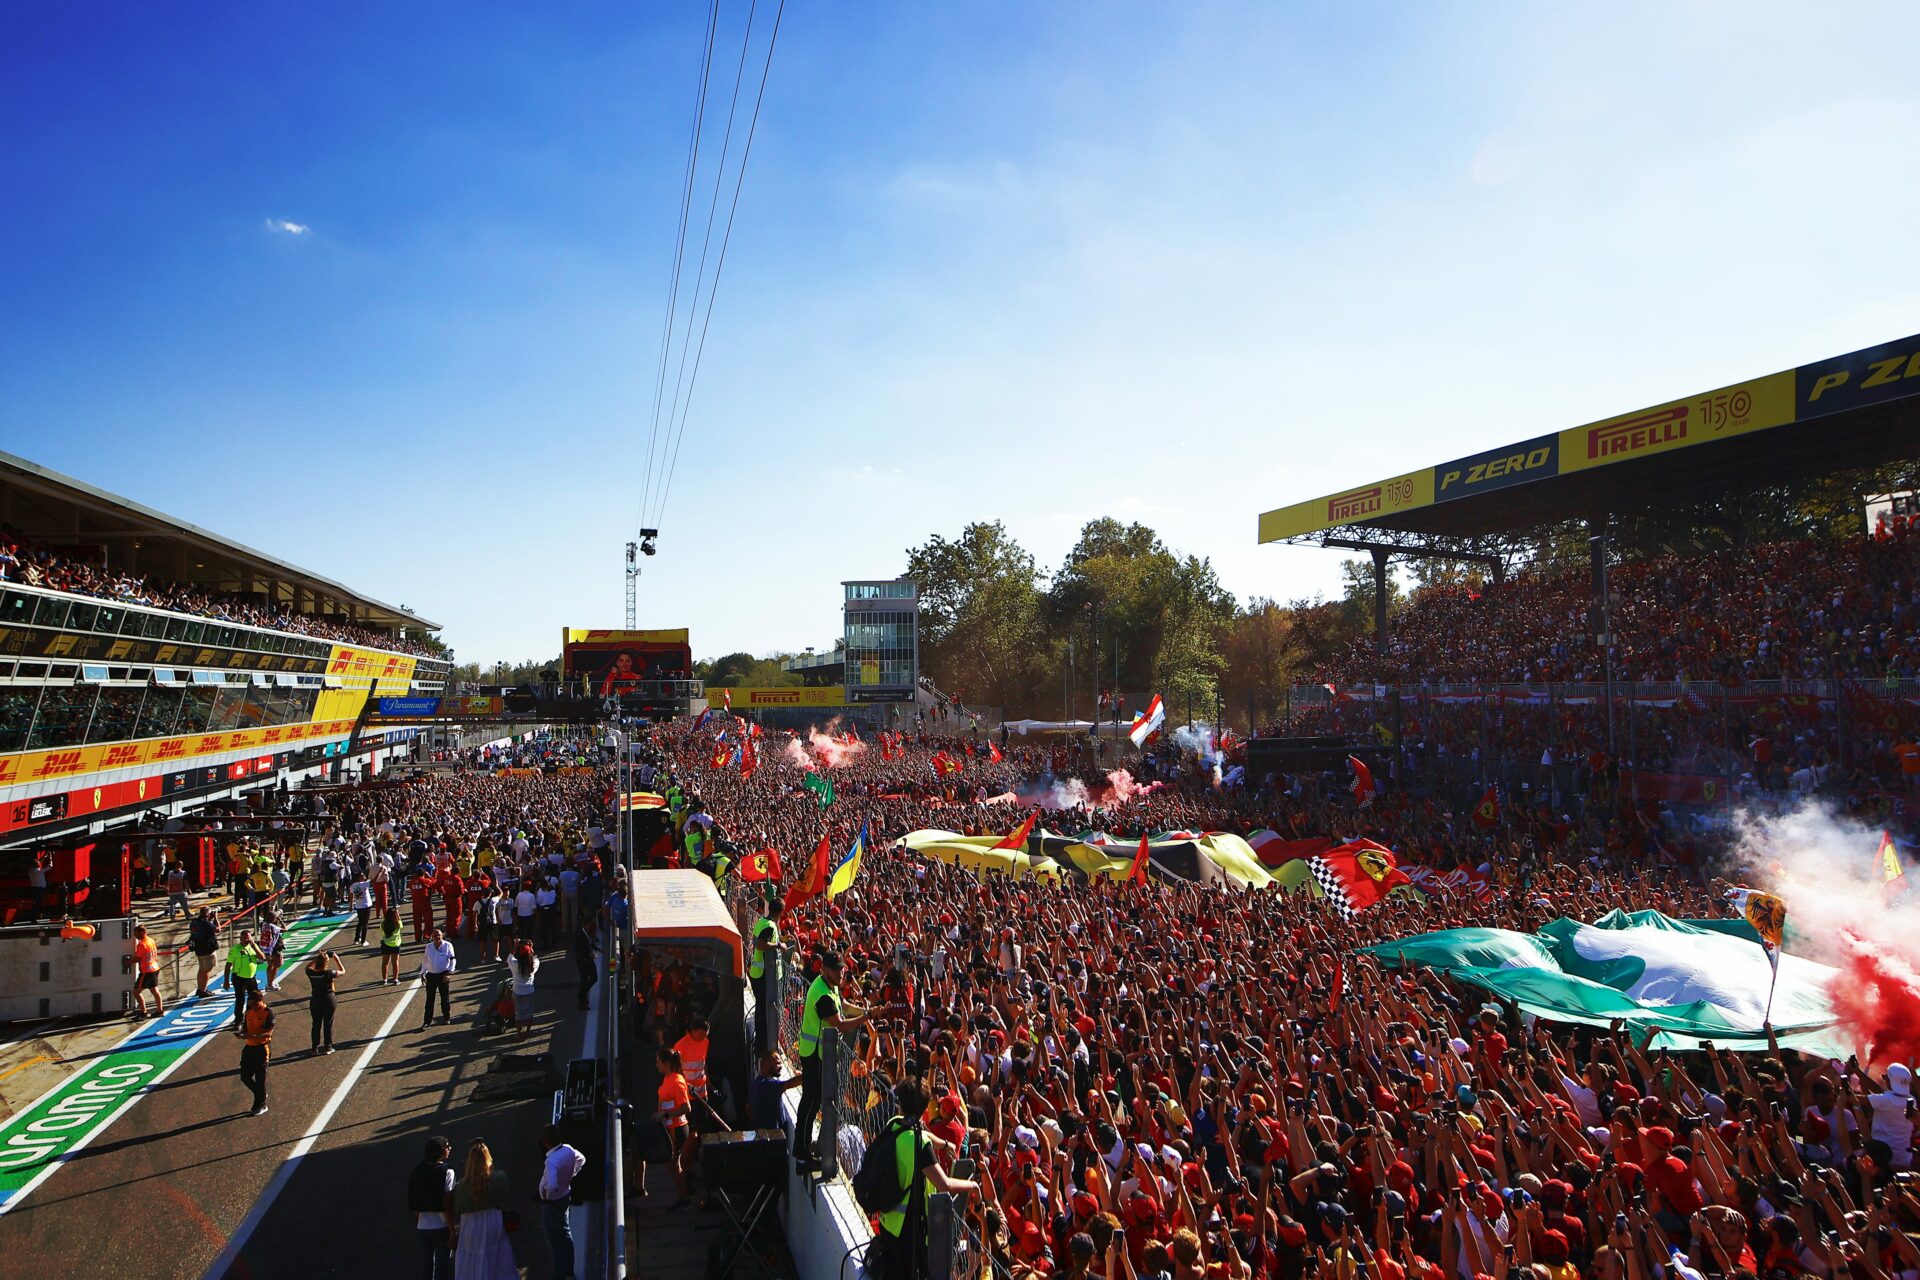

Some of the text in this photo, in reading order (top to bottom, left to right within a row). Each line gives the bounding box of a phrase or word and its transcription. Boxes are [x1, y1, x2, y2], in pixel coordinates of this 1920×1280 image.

[1808, 370, 1850, 402] P
[1588, 391, 1751, 460] PIRELLI 150
[1441, 447, 1551, 490] P ZERO
[1328, 479, 1413, 521] PIRELLI 150
[751, 691, 800, 703] PIRELLI
[40, 751, 81, 776] DHL
[13, 805, 26, 822] 16
